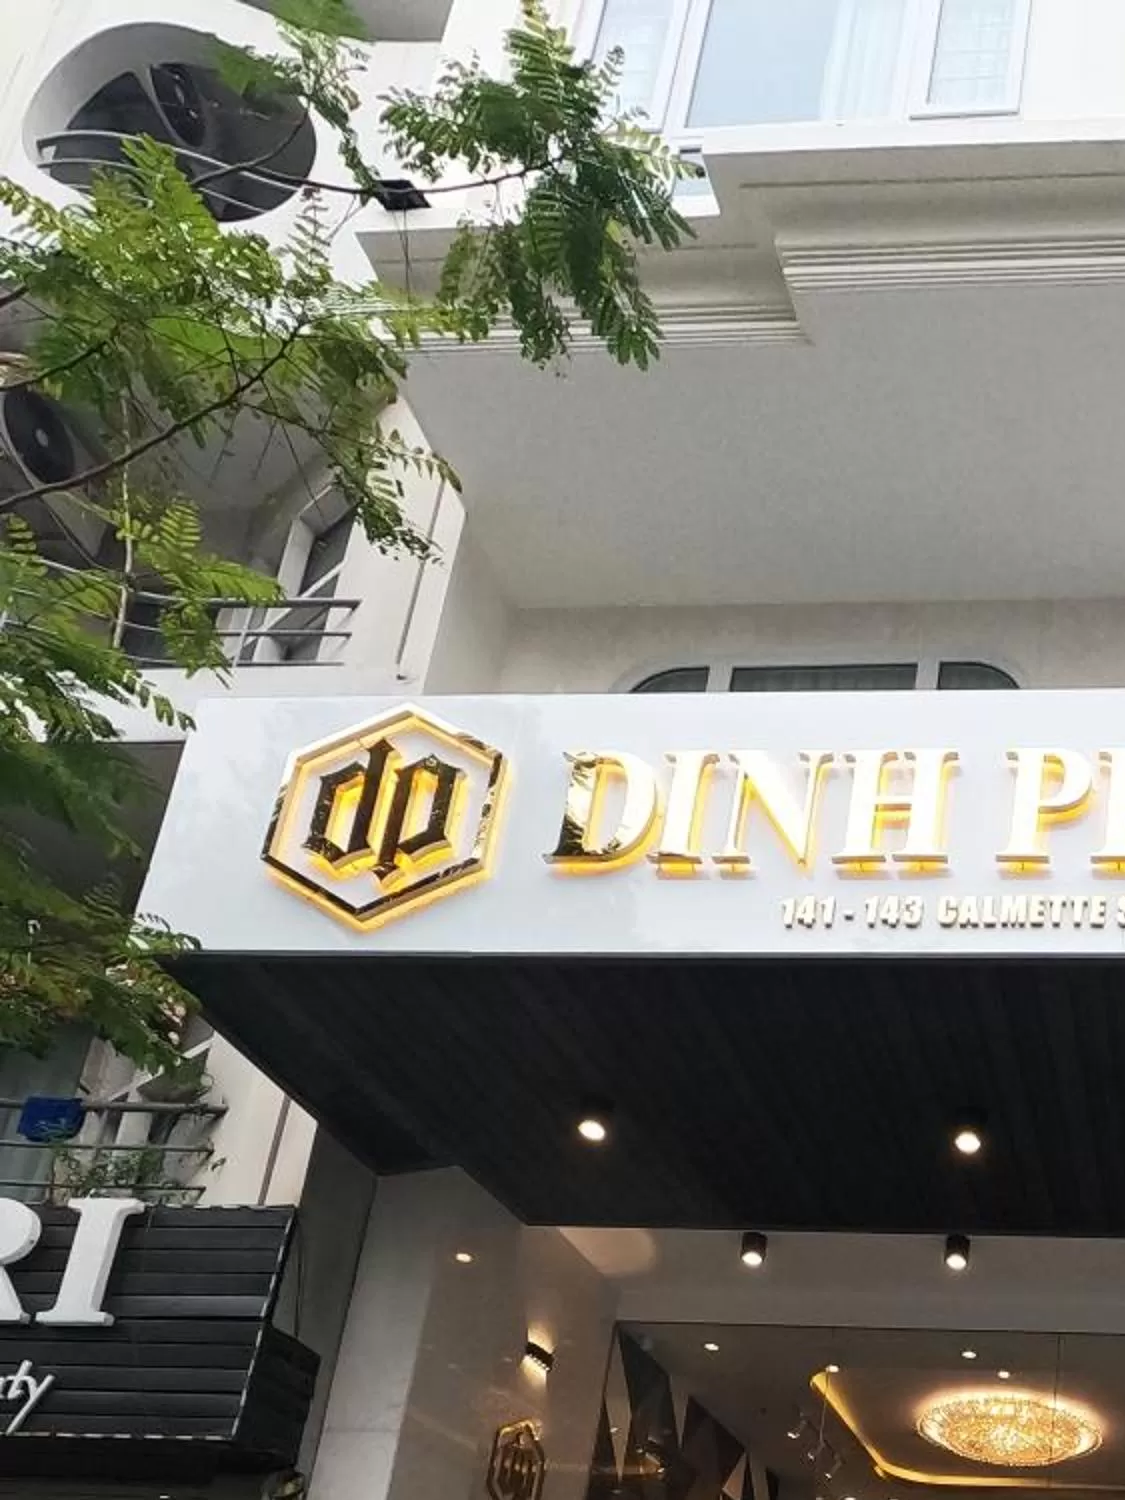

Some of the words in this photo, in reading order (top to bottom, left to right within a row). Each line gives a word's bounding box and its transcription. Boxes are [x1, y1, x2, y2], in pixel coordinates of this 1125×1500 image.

[545, 748, 960, 874] DINH
[780, 895, 836, 928] 141
[864, 895, 923, 928] 143
[936, 896, 1106, 928] CALMETTE
[0, 1359, 55, 1436] ty
